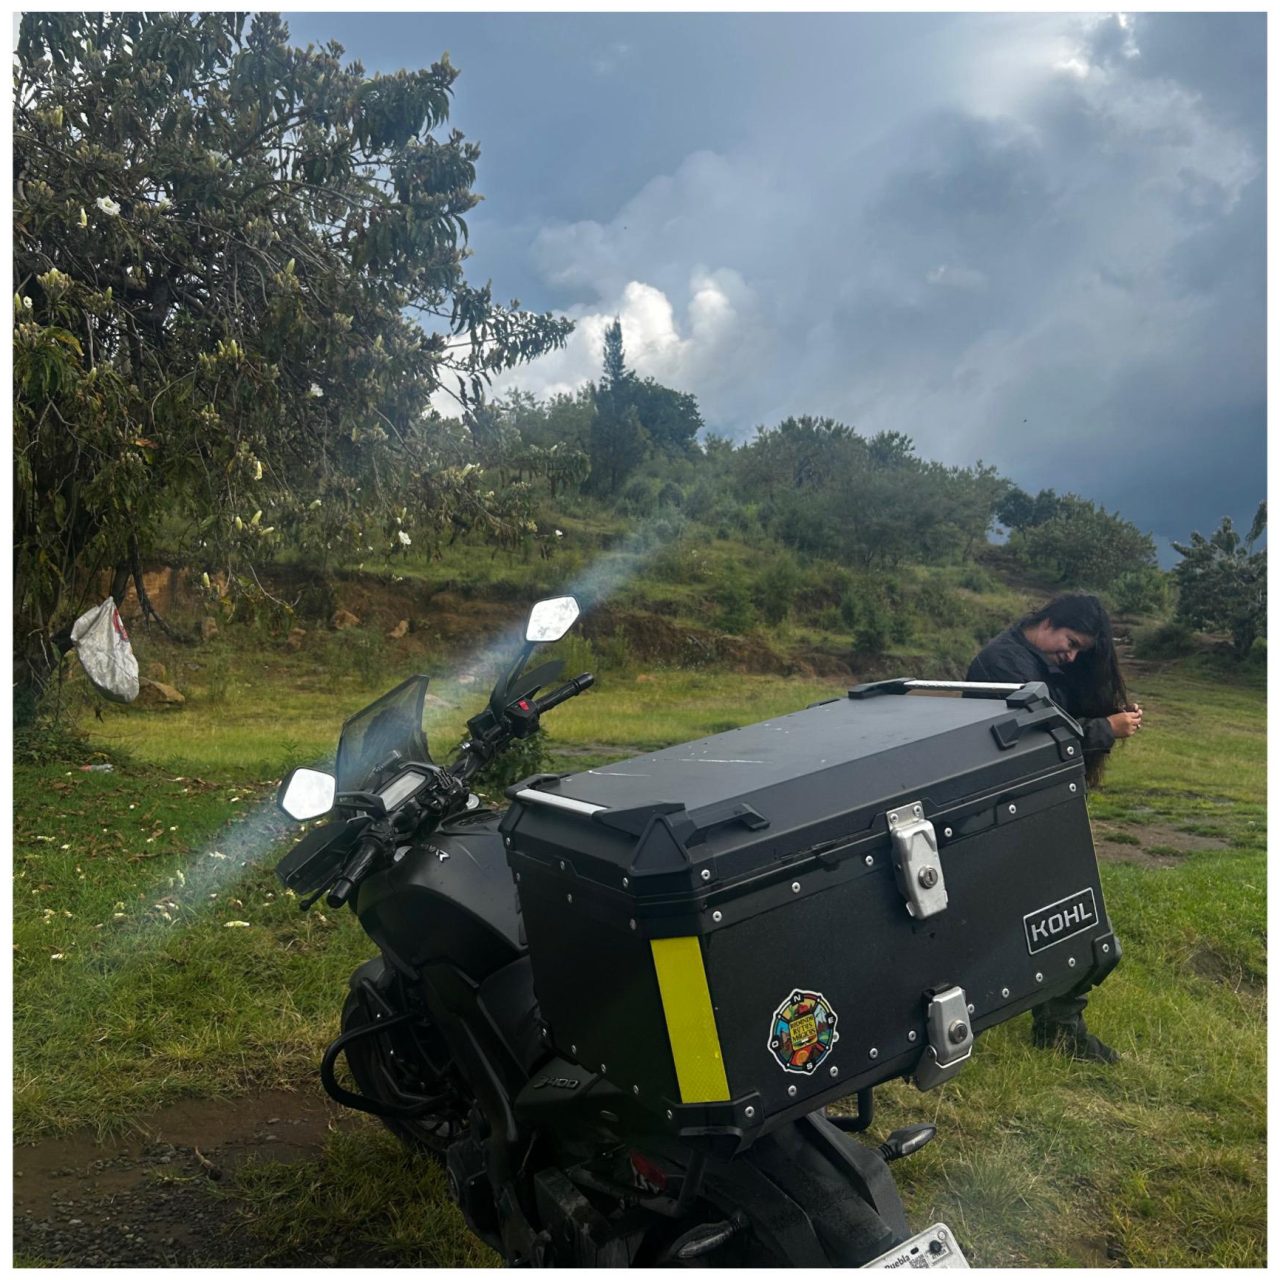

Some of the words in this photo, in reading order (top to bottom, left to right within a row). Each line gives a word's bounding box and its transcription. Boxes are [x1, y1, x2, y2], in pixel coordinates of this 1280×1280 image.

[1030, 902, 1093, 942] KOHL
[828, 1016, 834, 1024] E
[806, 1062, 813, 1070] S
